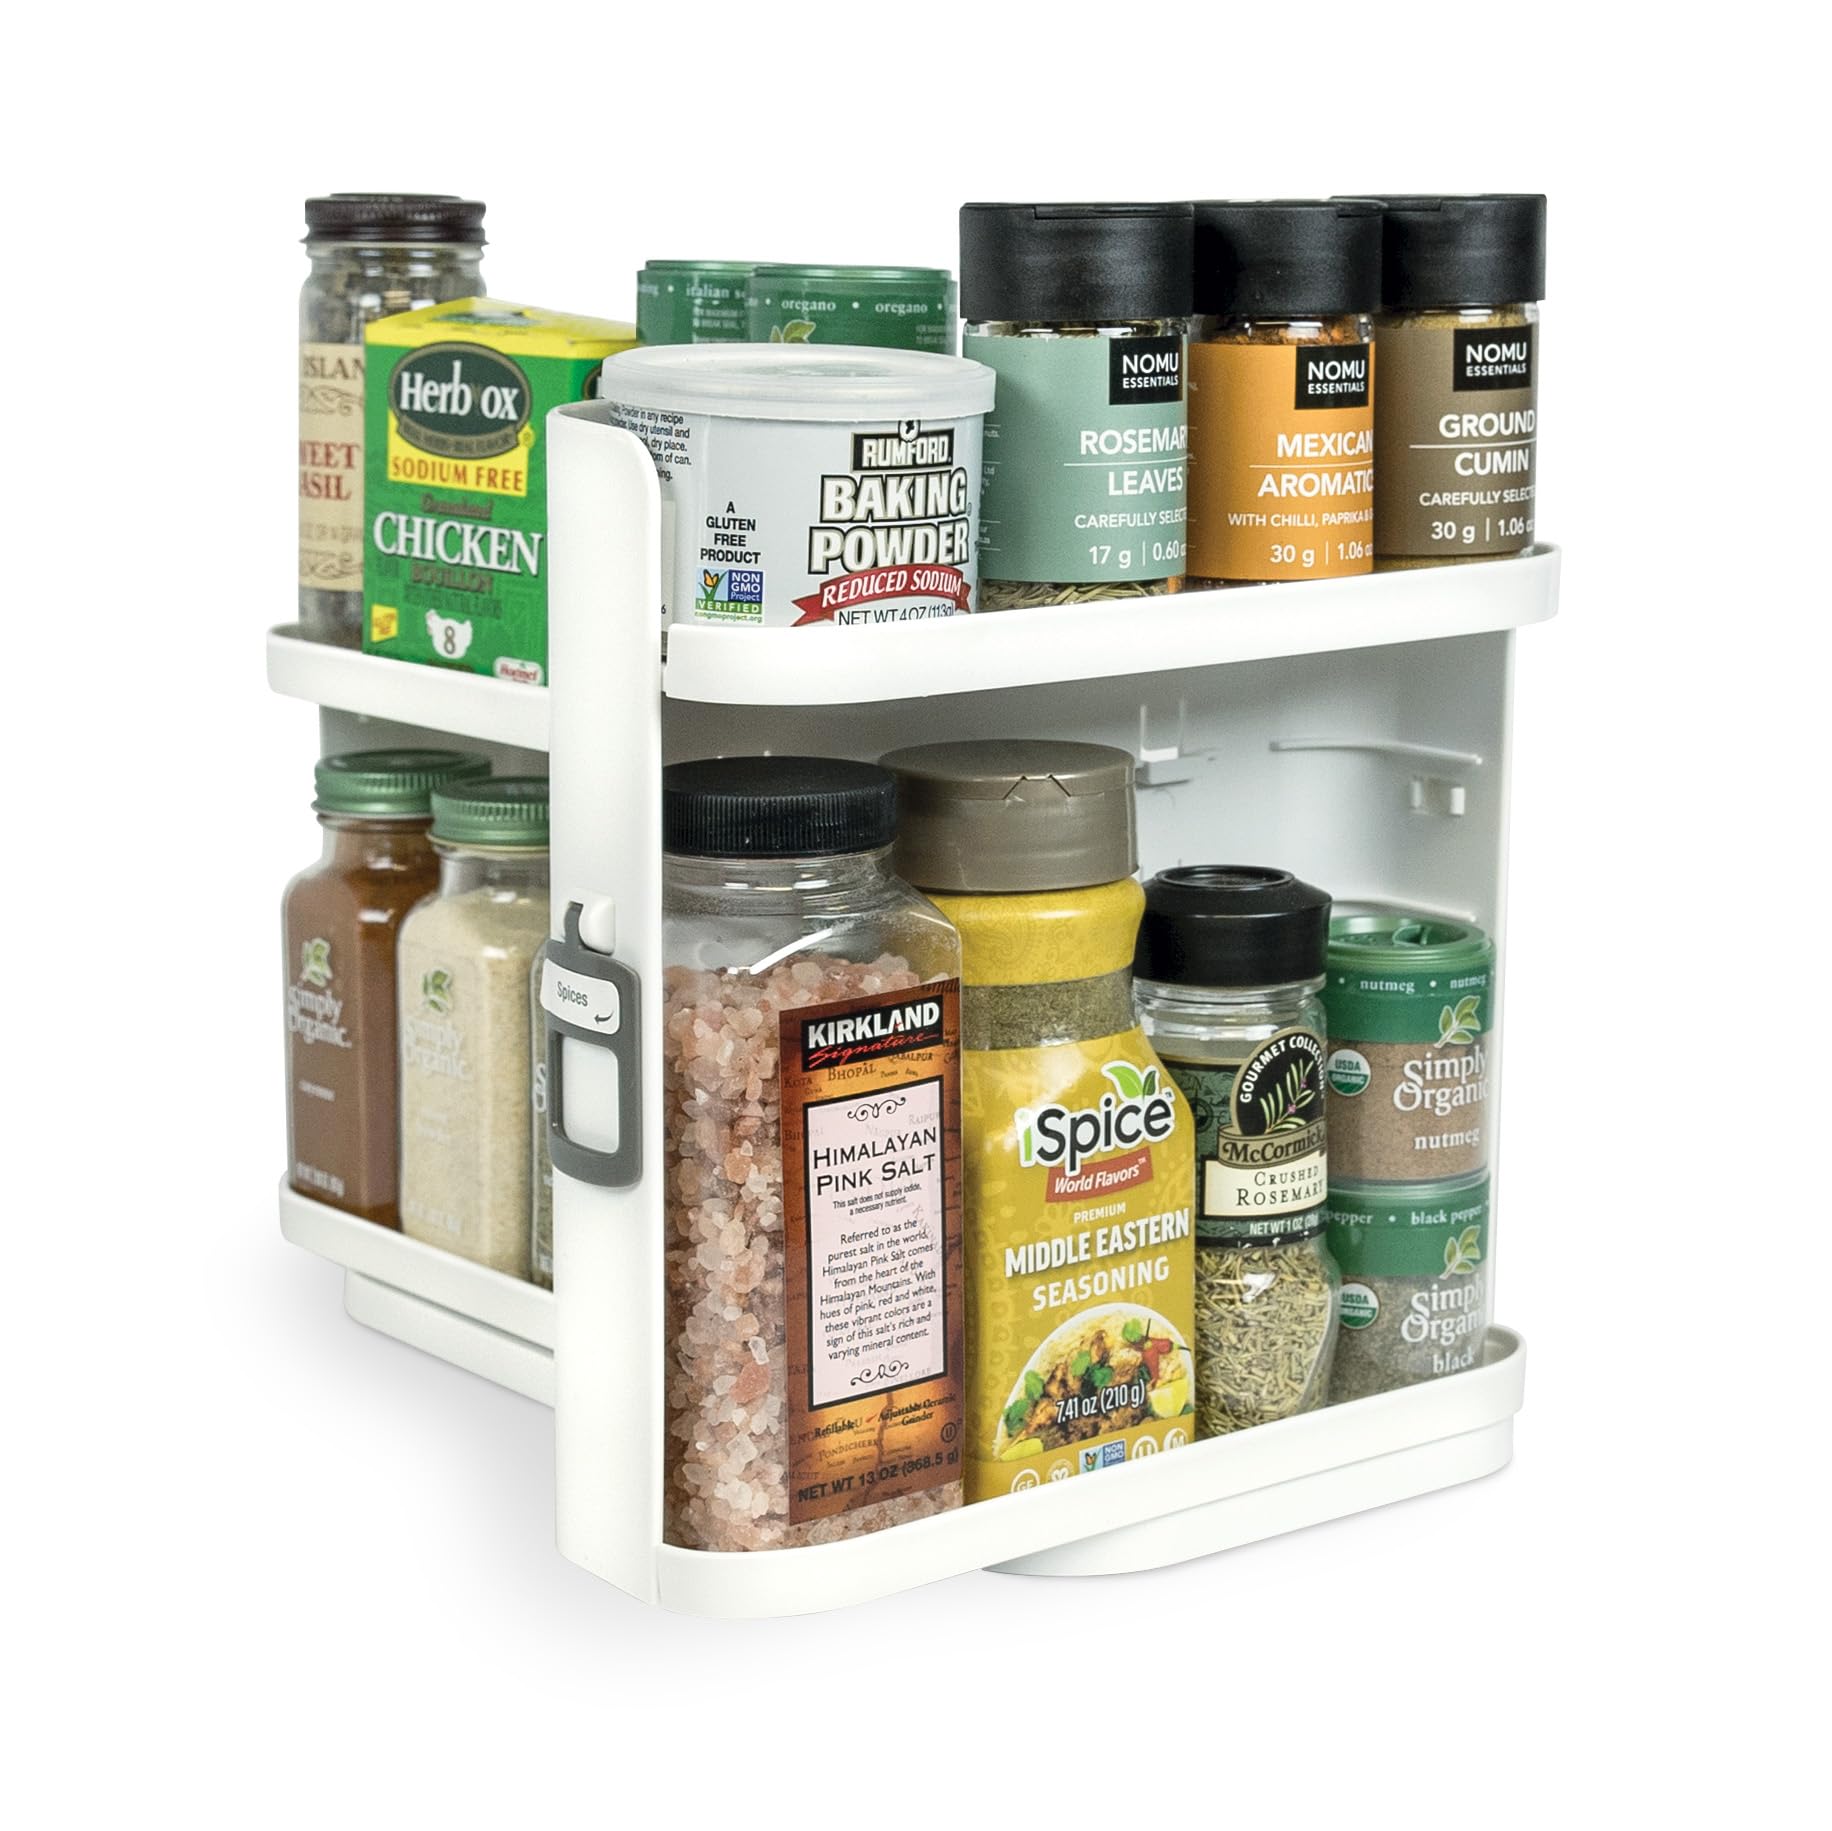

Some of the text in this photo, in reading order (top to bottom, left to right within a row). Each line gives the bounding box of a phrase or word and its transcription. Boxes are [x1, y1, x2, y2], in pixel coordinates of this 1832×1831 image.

[781, 299, 836, 312] oregano
[875, 302, 928, 316] oregano
[1122, 353, 1179, 375] NOMU
[1465, 342, 1527, 364] NOMU
[1123, 375, 1179, 389] ESSENTIALS
[1308, 360, 1365, 381] NOMU
[1466, 363, 1527, 377] ESSENTIALS
[400, 360, 519, 421] Herb ox
[1308, 381, 1365, 395] ESSENTIALS
[647, 411, 684, 426] any recipe
[1439, 409, 1536, 438] GROUND
[650, 425, 690, 439] utensil and
[1277, 429, 1373, 458] MEXICAN
[651, 439, 662, 451] dry
[664, 440, 687, 452] place.
[665, 453, 673, 463] of
[674, 456, 692, 466] can.
[1454, 449, 1529, 476] CUMIN
[392, 456, 524, 492] SODIUM FREE
[1108, 466, 1183, 496] LEAVES
[726, 501, 735, 514] A
[820, 467, 967, 524] BAKING
[1419, 490, 1501, 507] CAREFULLY
[706, 516, 757, 532] GLUTEN
[1074, 512, 1157, 529] CAREFULLY
[1228, 510, 1364, 528] WITH CHILLI, PAPRIKA
[1431, 516, 1524, 544] 30 g 1.06
[374, 511, 542, 576] CHICKEN
[714, 533, 747, 547] FREE
[808, 517, 970, 575] POWDER
[700, 548, 761, 564] PRODUCT
[1089, 540, 1179, 569] 17 g 0.60
[1270, 541, 1363, 568] 30 g 1.06
[731, 582, 760, 593] GMO
[732, 572, 760, 583] NON
[821, 569, 963, 609] REDUCED SODIUM
[699, 601, 760, 613] VERIFIED
[731, 592, 760, 602] Project
[838, 609, 898, 626] NET WT
[444, 625, 455, 654] 8
[557, 980, 588, 1007] Spices
[1360, 979, 1415, 993] nutmeg
[1450, 974, 1487, 990] nutmeg
[808, 1001, 940, 1049] KIRKLAND
[808, 1031, 939, 1069] Signature
[1240, 1039, 1286, 1103] GOURMET
[1335, 1059, 1361, 1071] USDA
[1019, 1096, 1172, 1172] iSpice
[1223, 1125, 1326, 1164] McCormick
[1415, 1127, 1481, 1150] nutmeg
[813, 1127, 937, 1169] HIMALAYAN
[817, 1153, 936, 1196] PINK SALT
[1054, 1168, 1092, 1194] World
[1254, 1164, 1319, 1186] CRUSHED
[832, 1187, 903, 1210] This salt does not supply
[1236, 1179, 1324, 1207] ROSEMARY
[855, 1202, 884, 1215] necessary
[1073, 1202, 1126, 1224] PREMIUM
[1411, 1204, 1482, 1225] black pepper
[840, 1218, 918, 1245] Referred to as the
[1250, 1216, 1303, 1235] NET WT OZ
[828, 1249, 857, 1265] purest
[859, 1243, 874, 1255] salt
[876, 1240, 885, 1251] in
[887, 1236, 900, 1248] the
[1004, 1208, 1190, 1278] MIDDLE EASTERN
[822, 1243, 934, 1277] Himalayan Pink Salt comes
[834, 1259, 924, 1289] from the heart of the
[1033, 1256, 1169, 1312] SEASONING
[820, 1269, 936, 1306] Himalayan Mountains. With
[820, 1308, 841, 1320] hues
[843, 1303, 853, 1314] of
[879, 1294, 893, 1306] red
[895, 1291, 910, 1303] and
[825, 1300, 932, 1333] these vibrant colors are a
[826, 1311, 931, 1348] sign of this salt's rich and
[828, 1347, 860, 1361] varying
[862, 1338, 894, 1353] mineral
[1432, 1347, 1475, 1374] black
[1057, 1378, 1145, 1424] 7.41 oz (210 g)
[1104, 1443, 1123, 1454] NON
[1104, 1450, 1124, 1462] GMO
[798, 1482, 828, 1503] NET
[831, 1476, 855, 1495] WT
[859, 1471, 876, 1487] 13
[879, 1464, 899, 1480] OZ
[902, 1451, 943, 1478] (368.5
